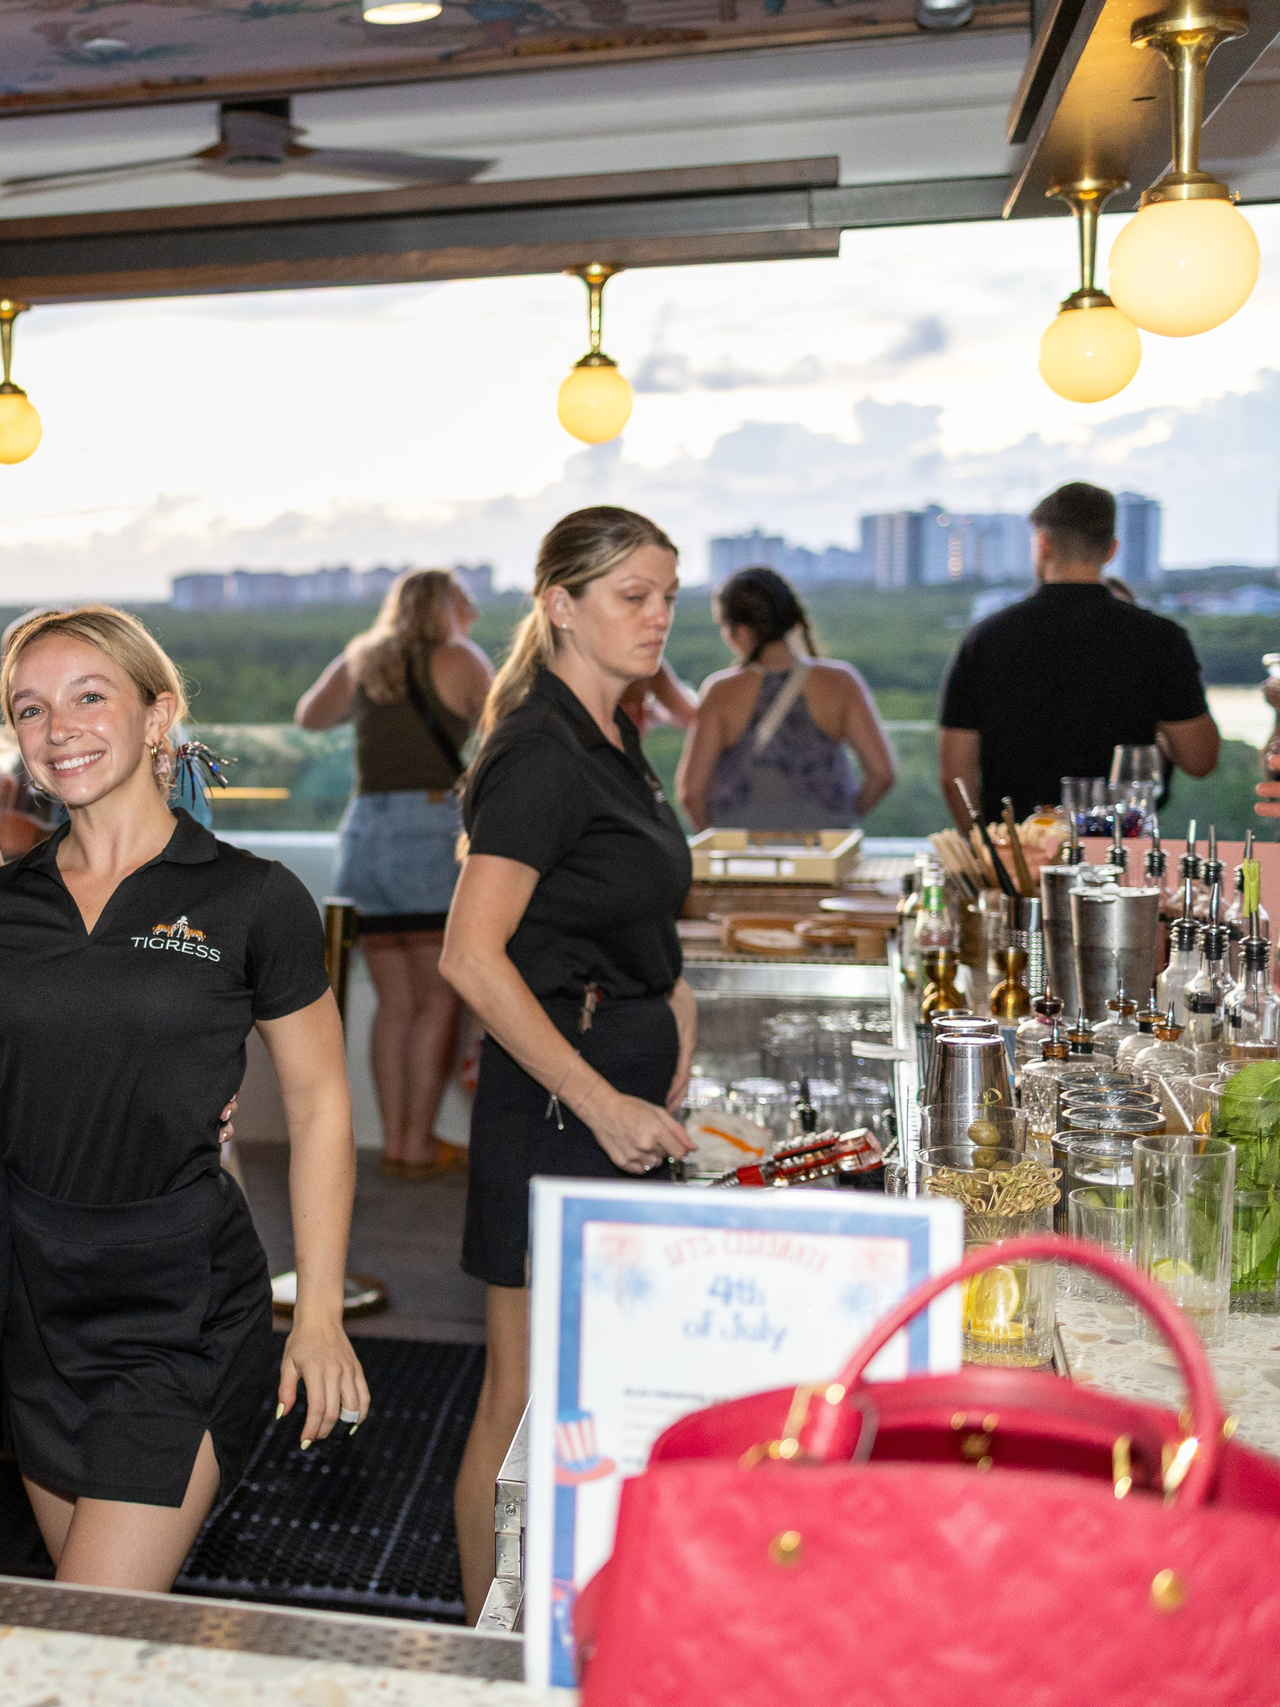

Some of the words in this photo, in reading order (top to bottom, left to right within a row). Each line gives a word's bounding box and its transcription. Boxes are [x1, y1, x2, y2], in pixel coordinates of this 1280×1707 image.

[131, 935, 221, 963] TIGRESS
[708, 1273, 767, 1306] 4th
[682, 1308, 714, 1338] of
[721, 1310, 789, 1353] July
